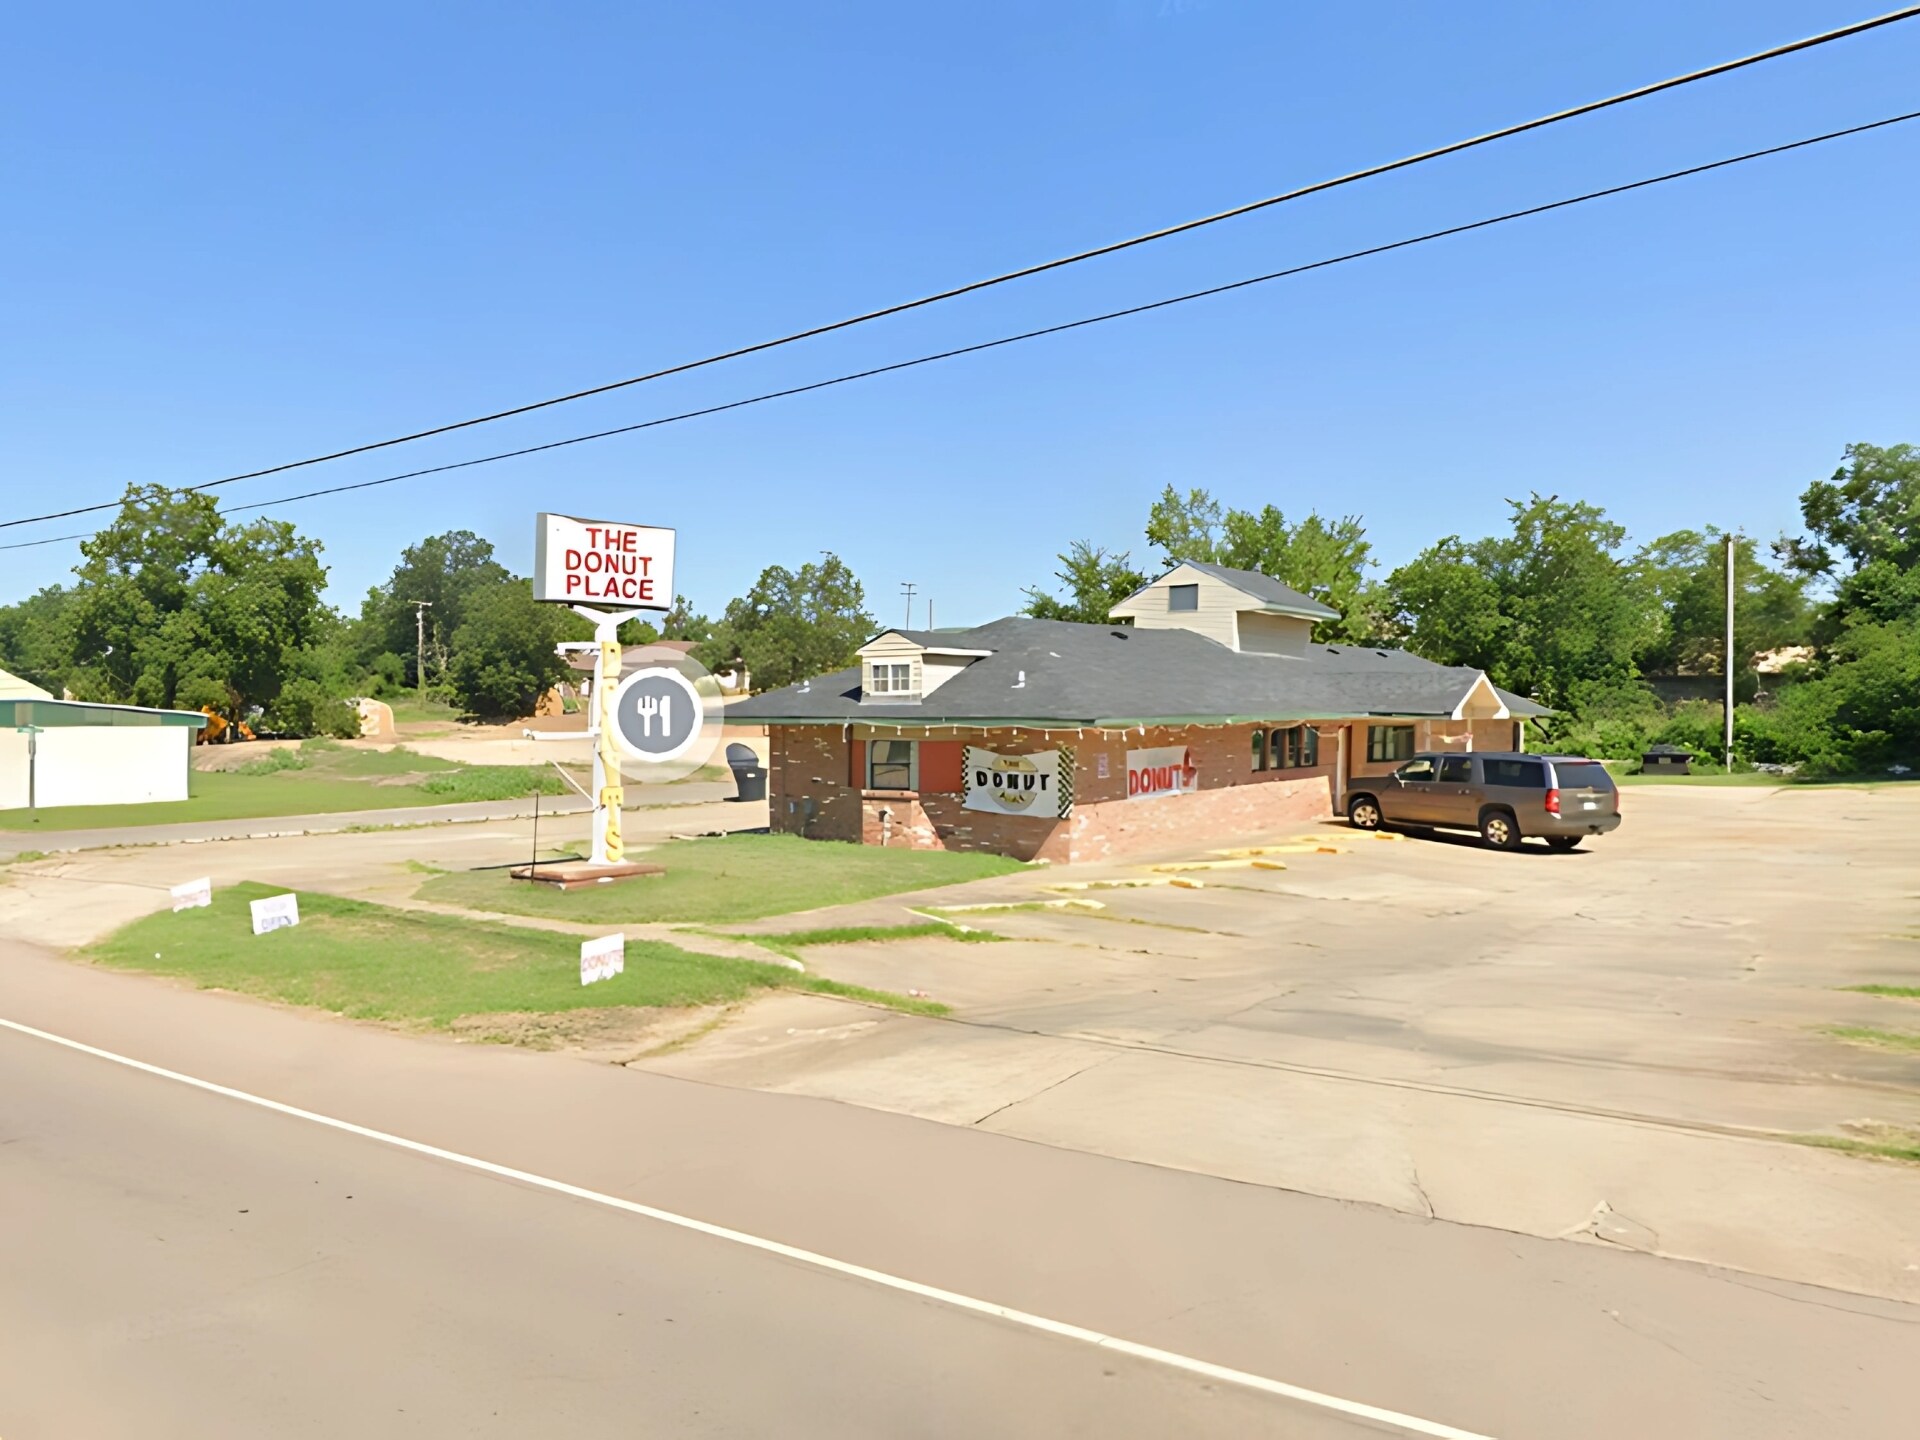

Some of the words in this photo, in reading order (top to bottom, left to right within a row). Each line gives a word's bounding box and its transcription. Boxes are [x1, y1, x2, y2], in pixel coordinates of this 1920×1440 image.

[586, 528, 637, 553] THE
[565, 549, 652, 576] DONUT
[566, 574, 653, 601] PLACE
[976, 770, 1050, 791] DONUT
